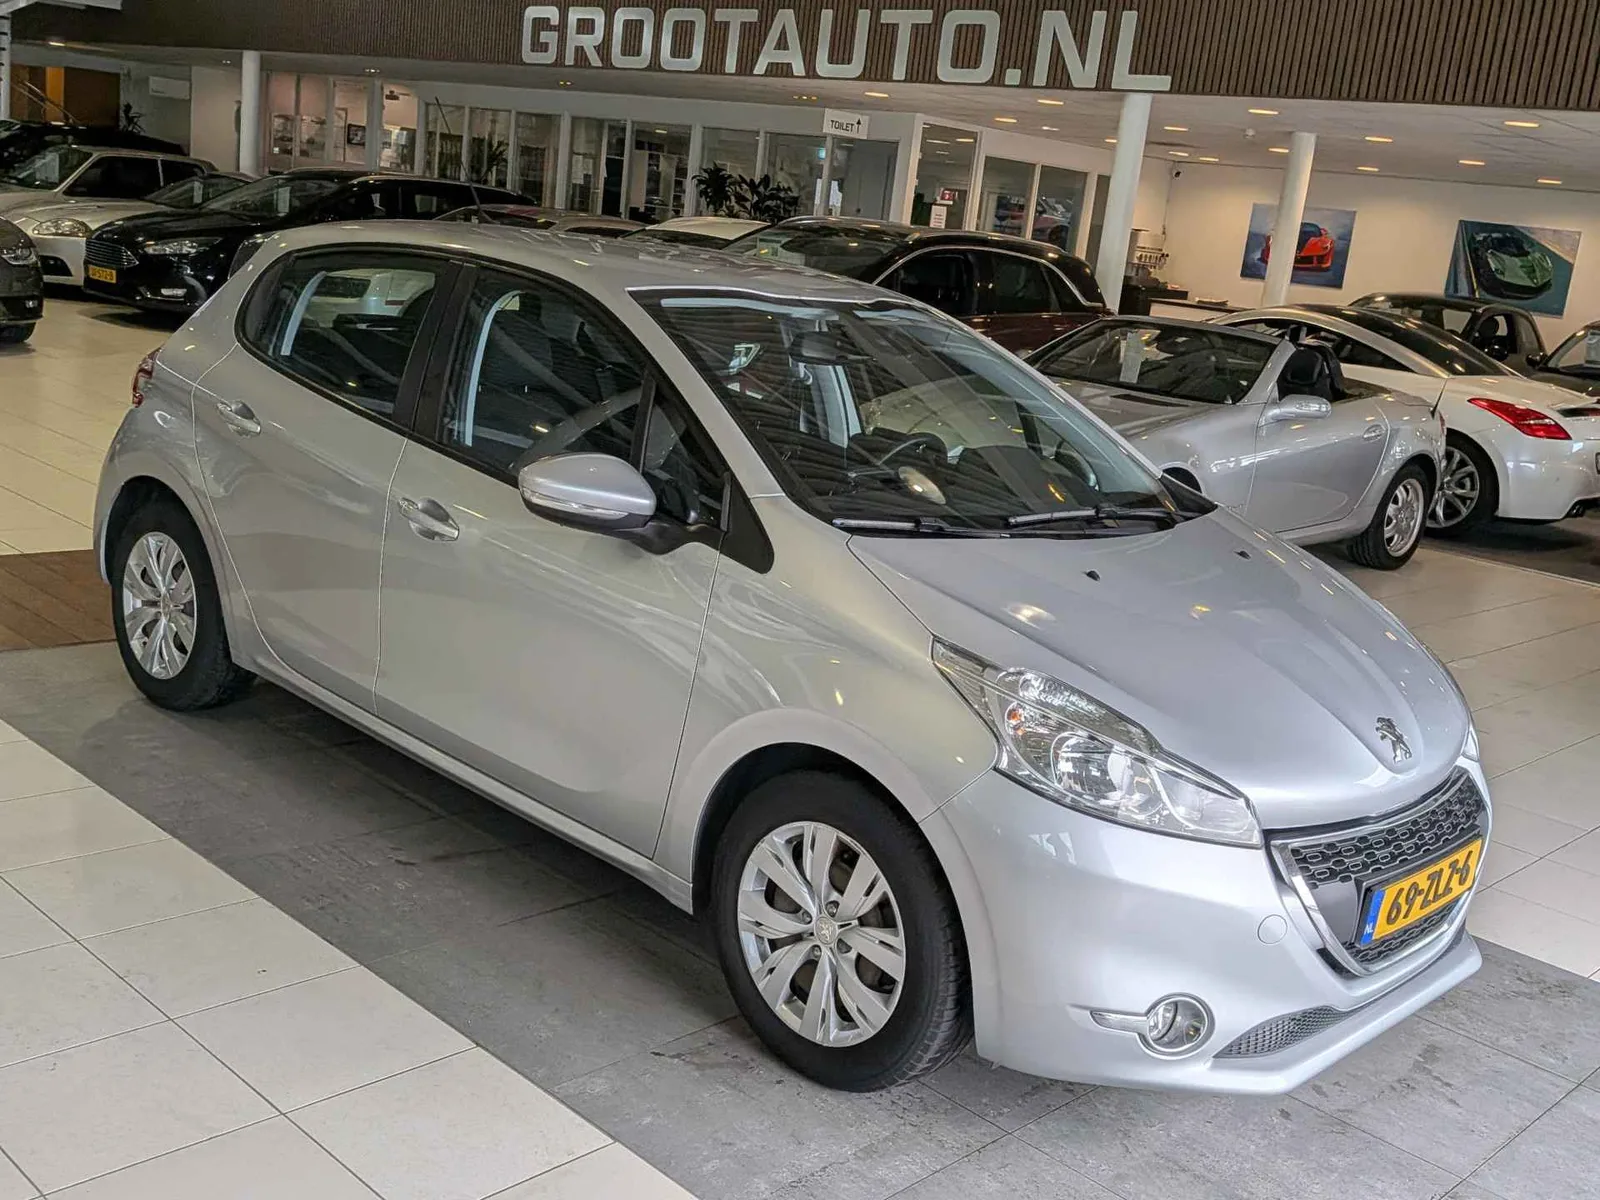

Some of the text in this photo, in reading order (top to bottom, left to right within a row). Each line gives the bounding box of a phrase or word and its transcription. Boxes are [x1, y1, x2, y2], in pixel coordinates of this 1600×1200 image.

[521, 6, 1172, 91] GROOTAUTO.NL
[830, 119, 854, 132] TOILET
[1386, 850, 1473, 925] 69-ZLZ-6
[1363, 922, 1374, 935] NL
